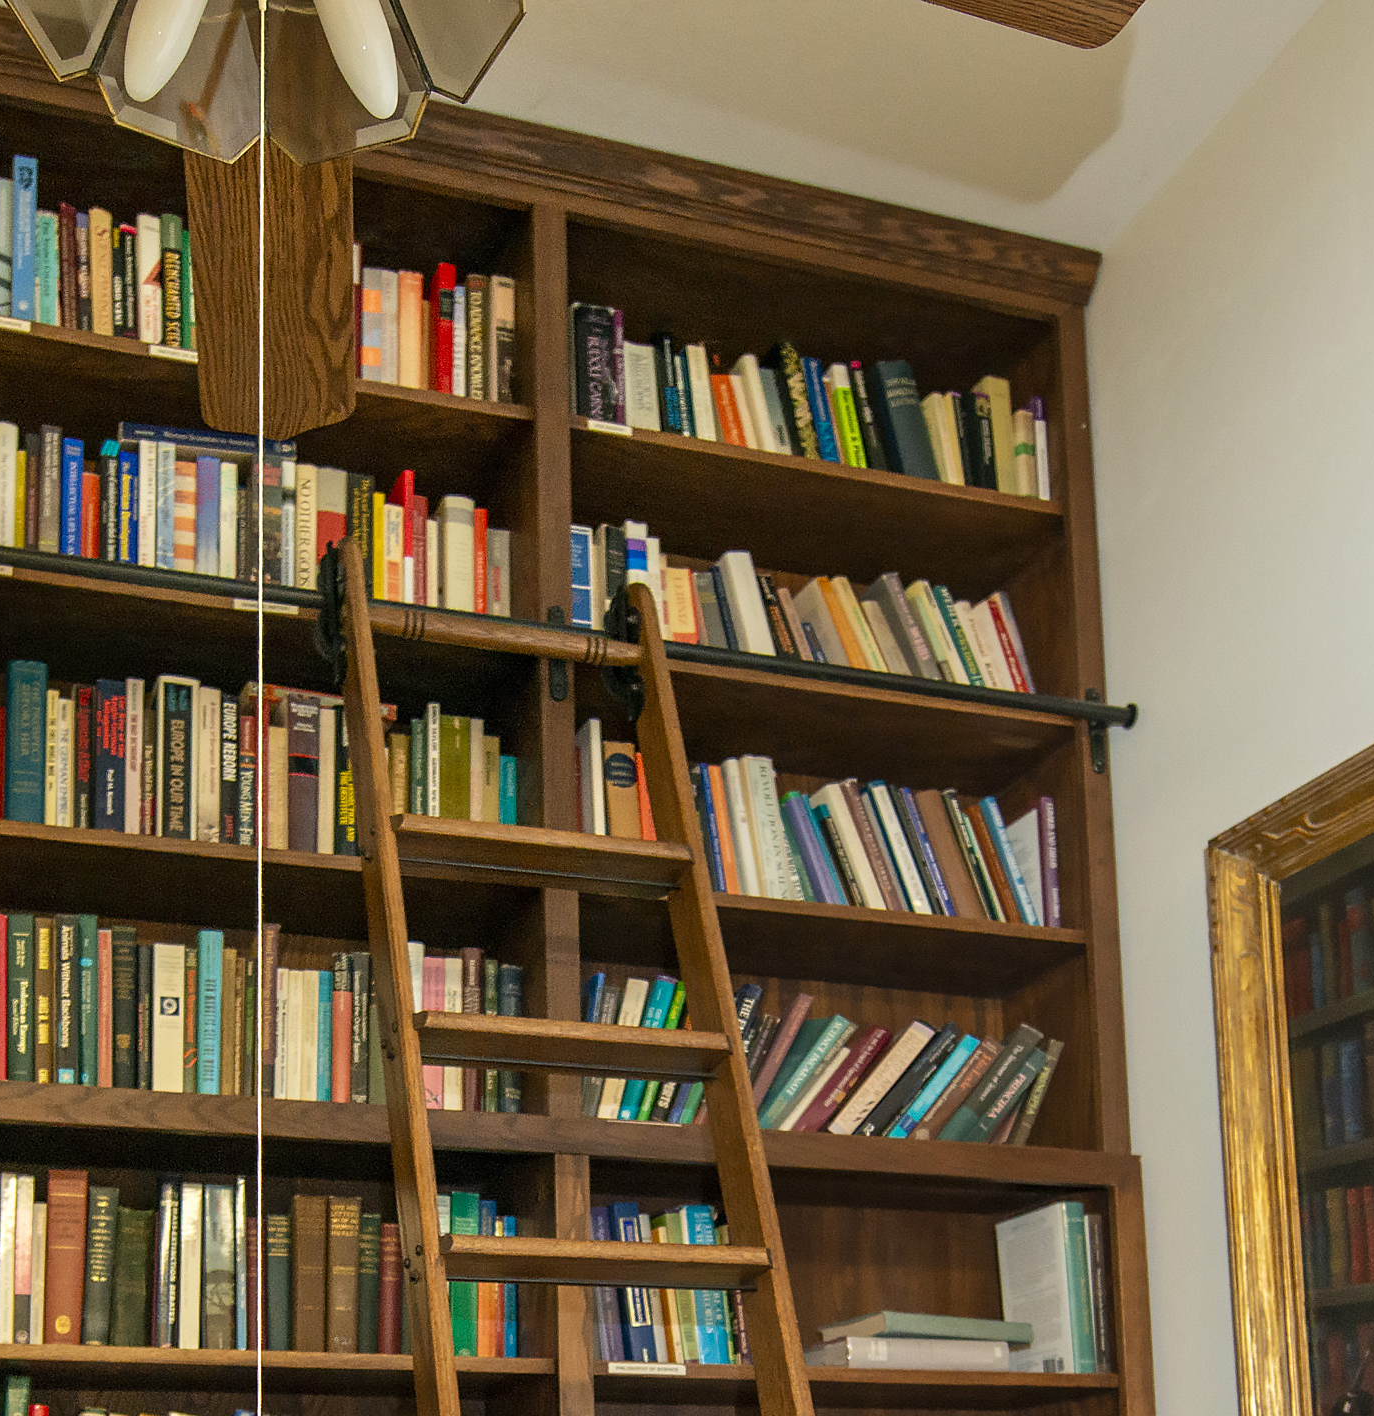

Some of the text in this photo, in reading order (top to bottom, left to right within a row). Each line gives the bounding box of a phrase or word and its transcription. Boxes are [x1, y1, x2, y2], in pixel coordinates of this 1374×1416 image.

[299, 478, 312, 586] NO OTHER GODS
[169, 719, 185, 831] EUROPE IN OUR TIME
[222, 703, 236, 781] EUROPE REBORN
[60, 925, 72, 1047] Animals Without Backbones
[988, 1073, 1028, 1119] PRINCIPIA
